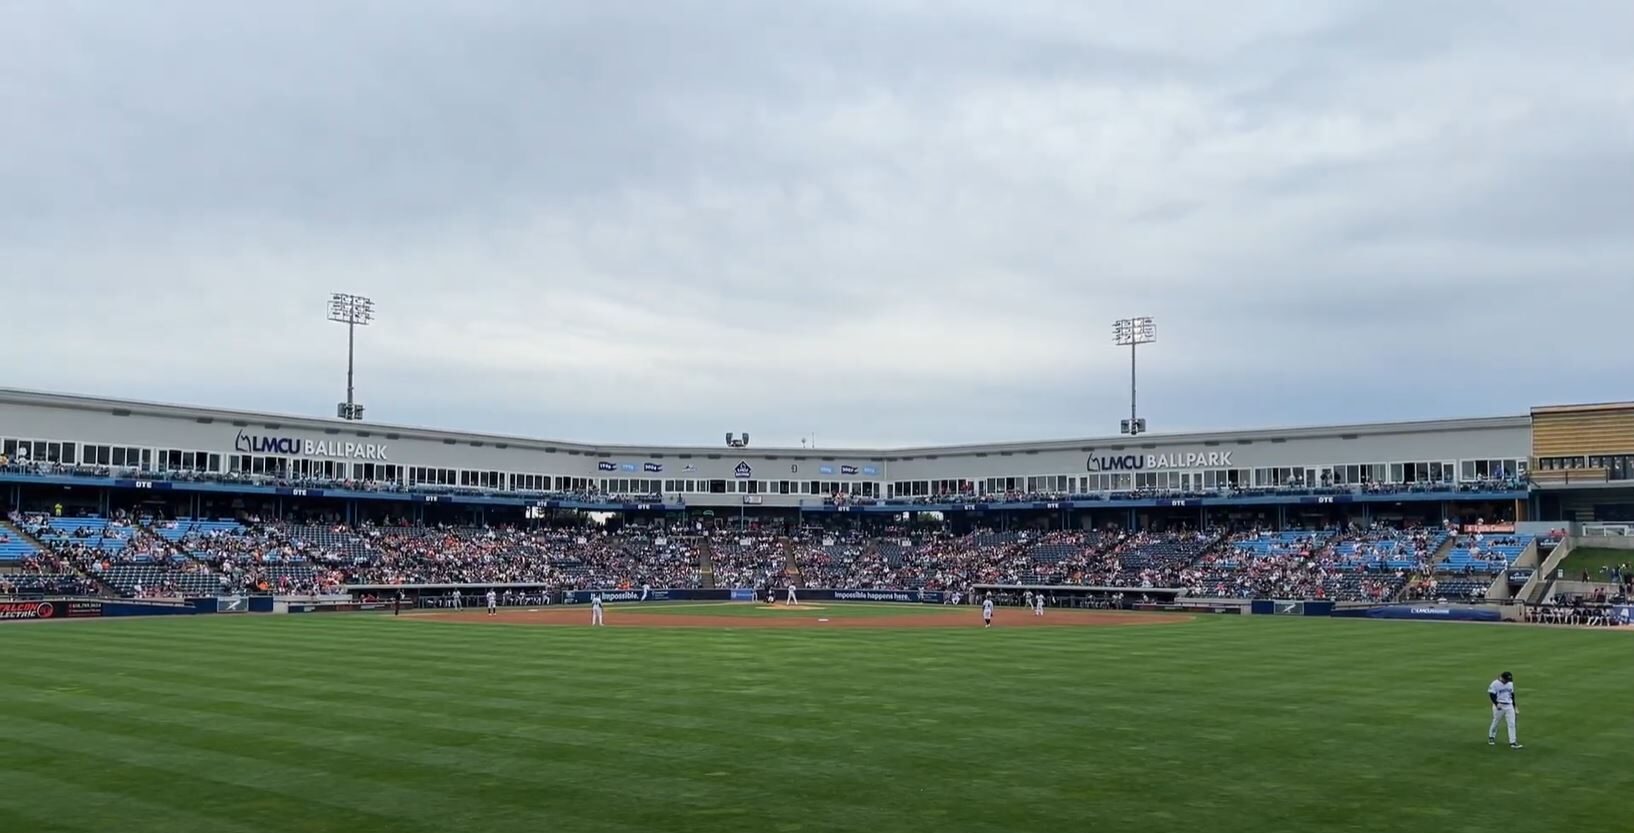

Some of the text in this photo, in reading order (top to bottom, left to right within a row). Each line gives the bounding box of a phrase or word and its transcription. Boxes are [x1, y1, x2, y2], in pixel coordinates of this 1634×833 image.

[252, 436, 388, 460] LMCU BALLPARK
[1101, 451, 1233, 471] LMCU BALLPARK
[602, 592, 639, 601] Impossible.
[867, 592, 893, 600] happens
